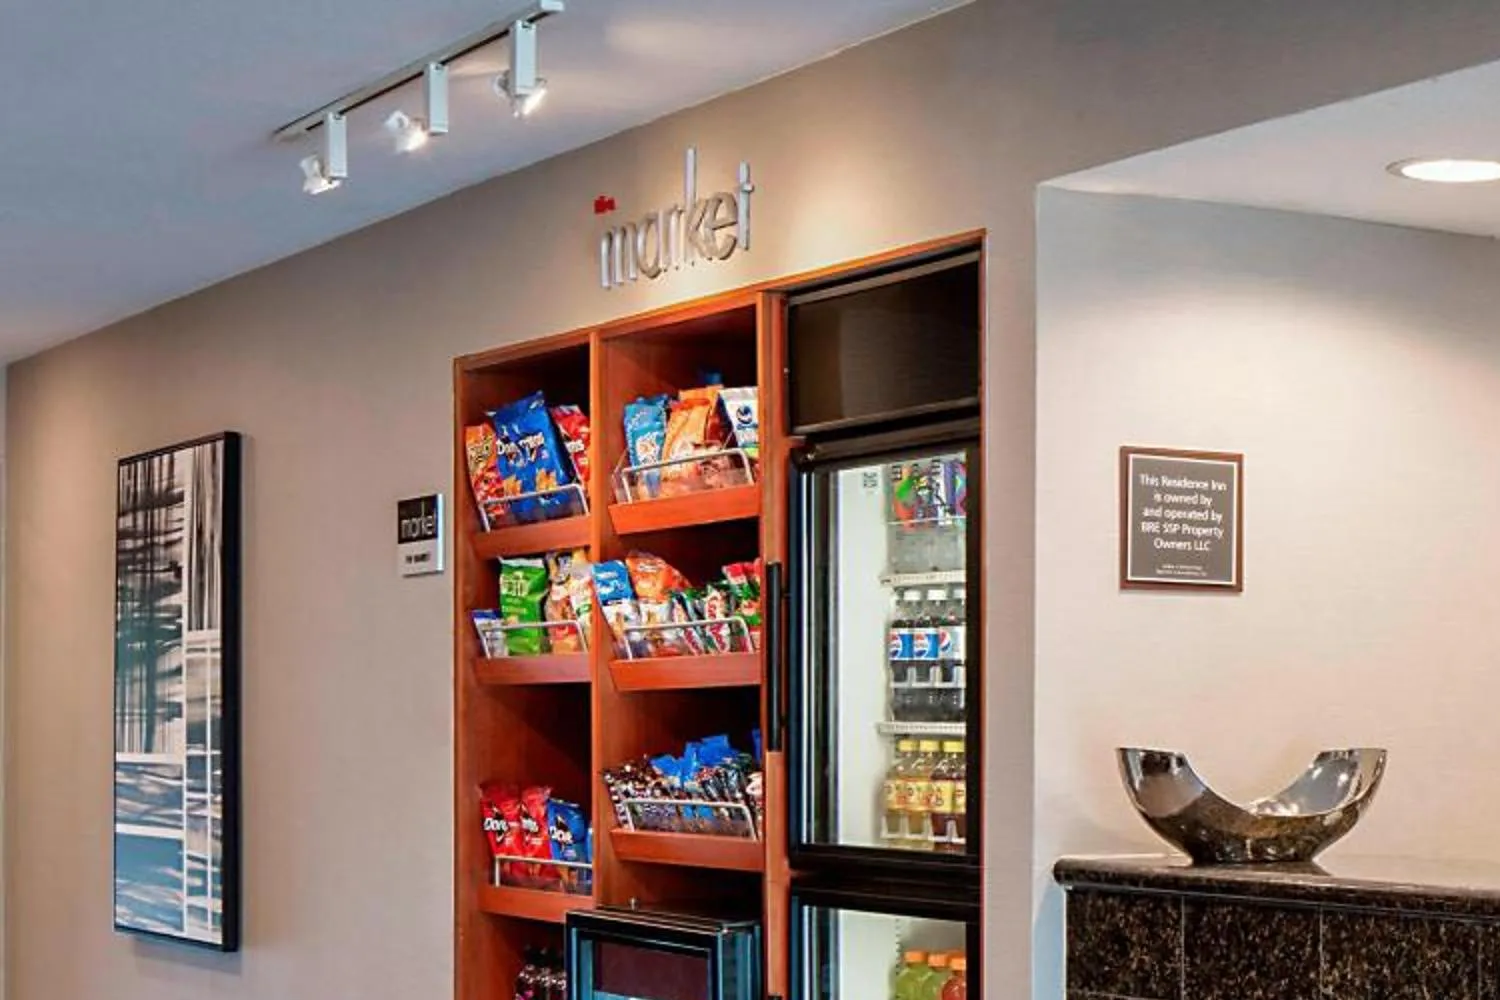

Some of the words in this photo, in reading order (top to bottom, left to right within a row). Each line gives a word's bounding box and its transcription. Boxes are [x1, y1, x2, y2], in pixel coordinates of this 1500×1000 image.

[599, 144, 755, 289] market
[1140, 473, 1159, 487] This
[1161, 475, 1209, 490] Residence
[1211, 479, 1228, 491] Inn
[1153, 489, 1161, 503] is
[1163, 491, 1199, 505] owned
[1200, 494, 1213, 508] by
[1142, 506, 1163, 518] and
[1163, 508, 1209, 521] operated
[1211, 509, 1223, 525] by
[1181, 523, 1224, 540] Property
[1153, 537, 1192, 551] Owners
[1193, 539, 1211, 552] LLC
